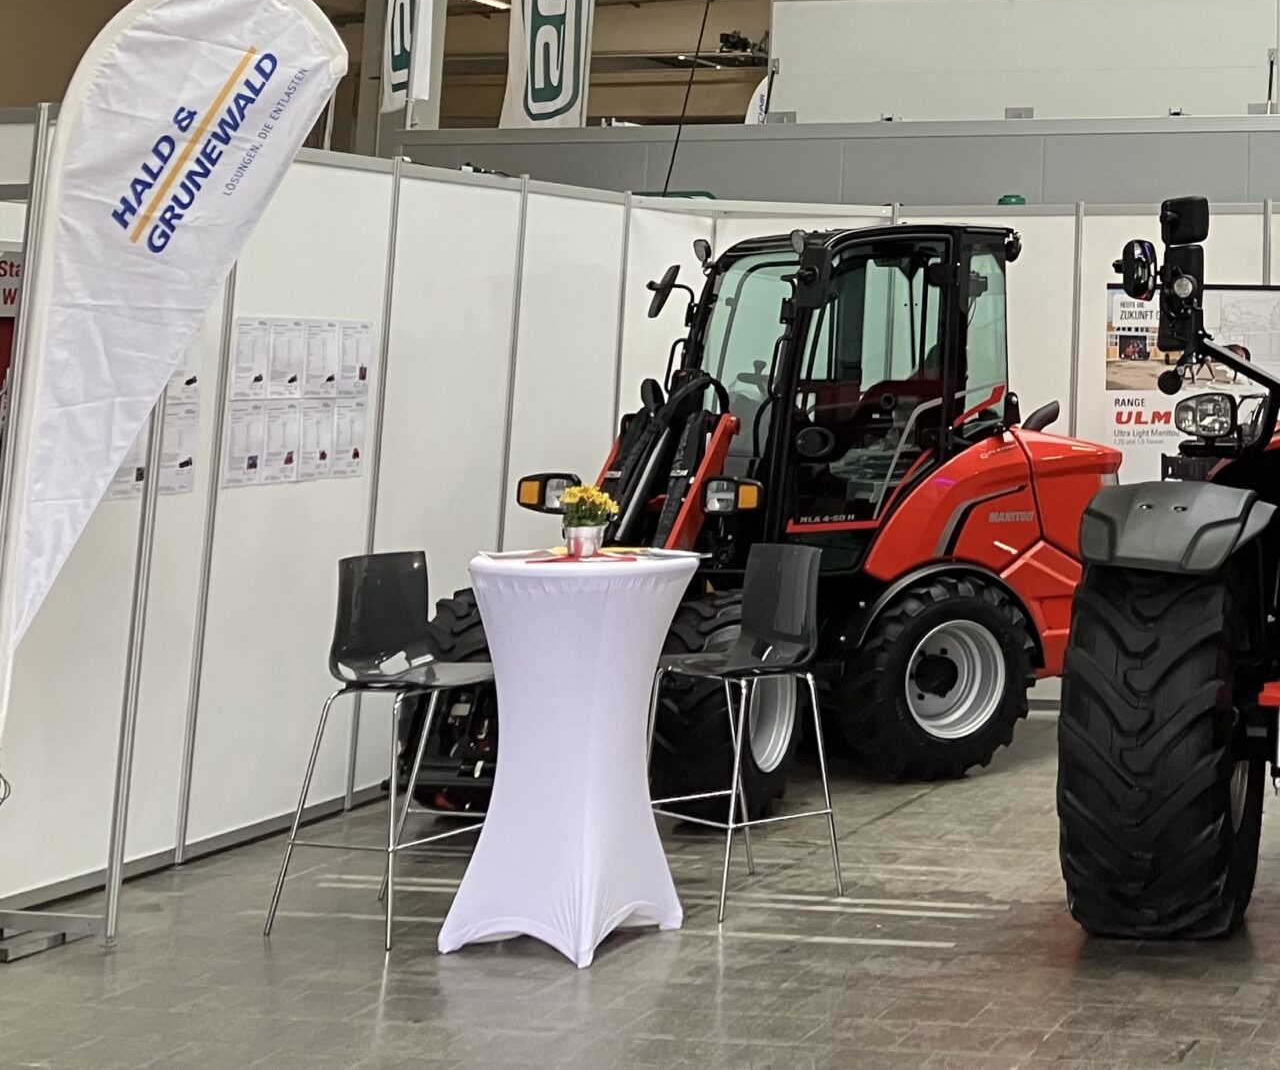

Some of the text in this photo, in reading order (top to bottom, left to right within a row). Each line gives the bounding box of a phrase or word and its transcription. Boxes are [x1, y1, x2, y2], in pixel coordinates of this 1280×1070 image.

[258, 122, 274, 140] DIE
[270, 68, 308, 121] ENTLASTEN
[147, 53, 278, 253] GRUNEWALD
[111, 106, 197, 230] HALD &
[1120, 310, 1153, 320] ZUKUNFT
[1115, 398, 1146, 408] RANGE
[1115, 411, 1171, 425] ULM
[1114, 429, 1180, 438] Ultra Light Manitou
[989, 511, 1034, 523] MANITOU
